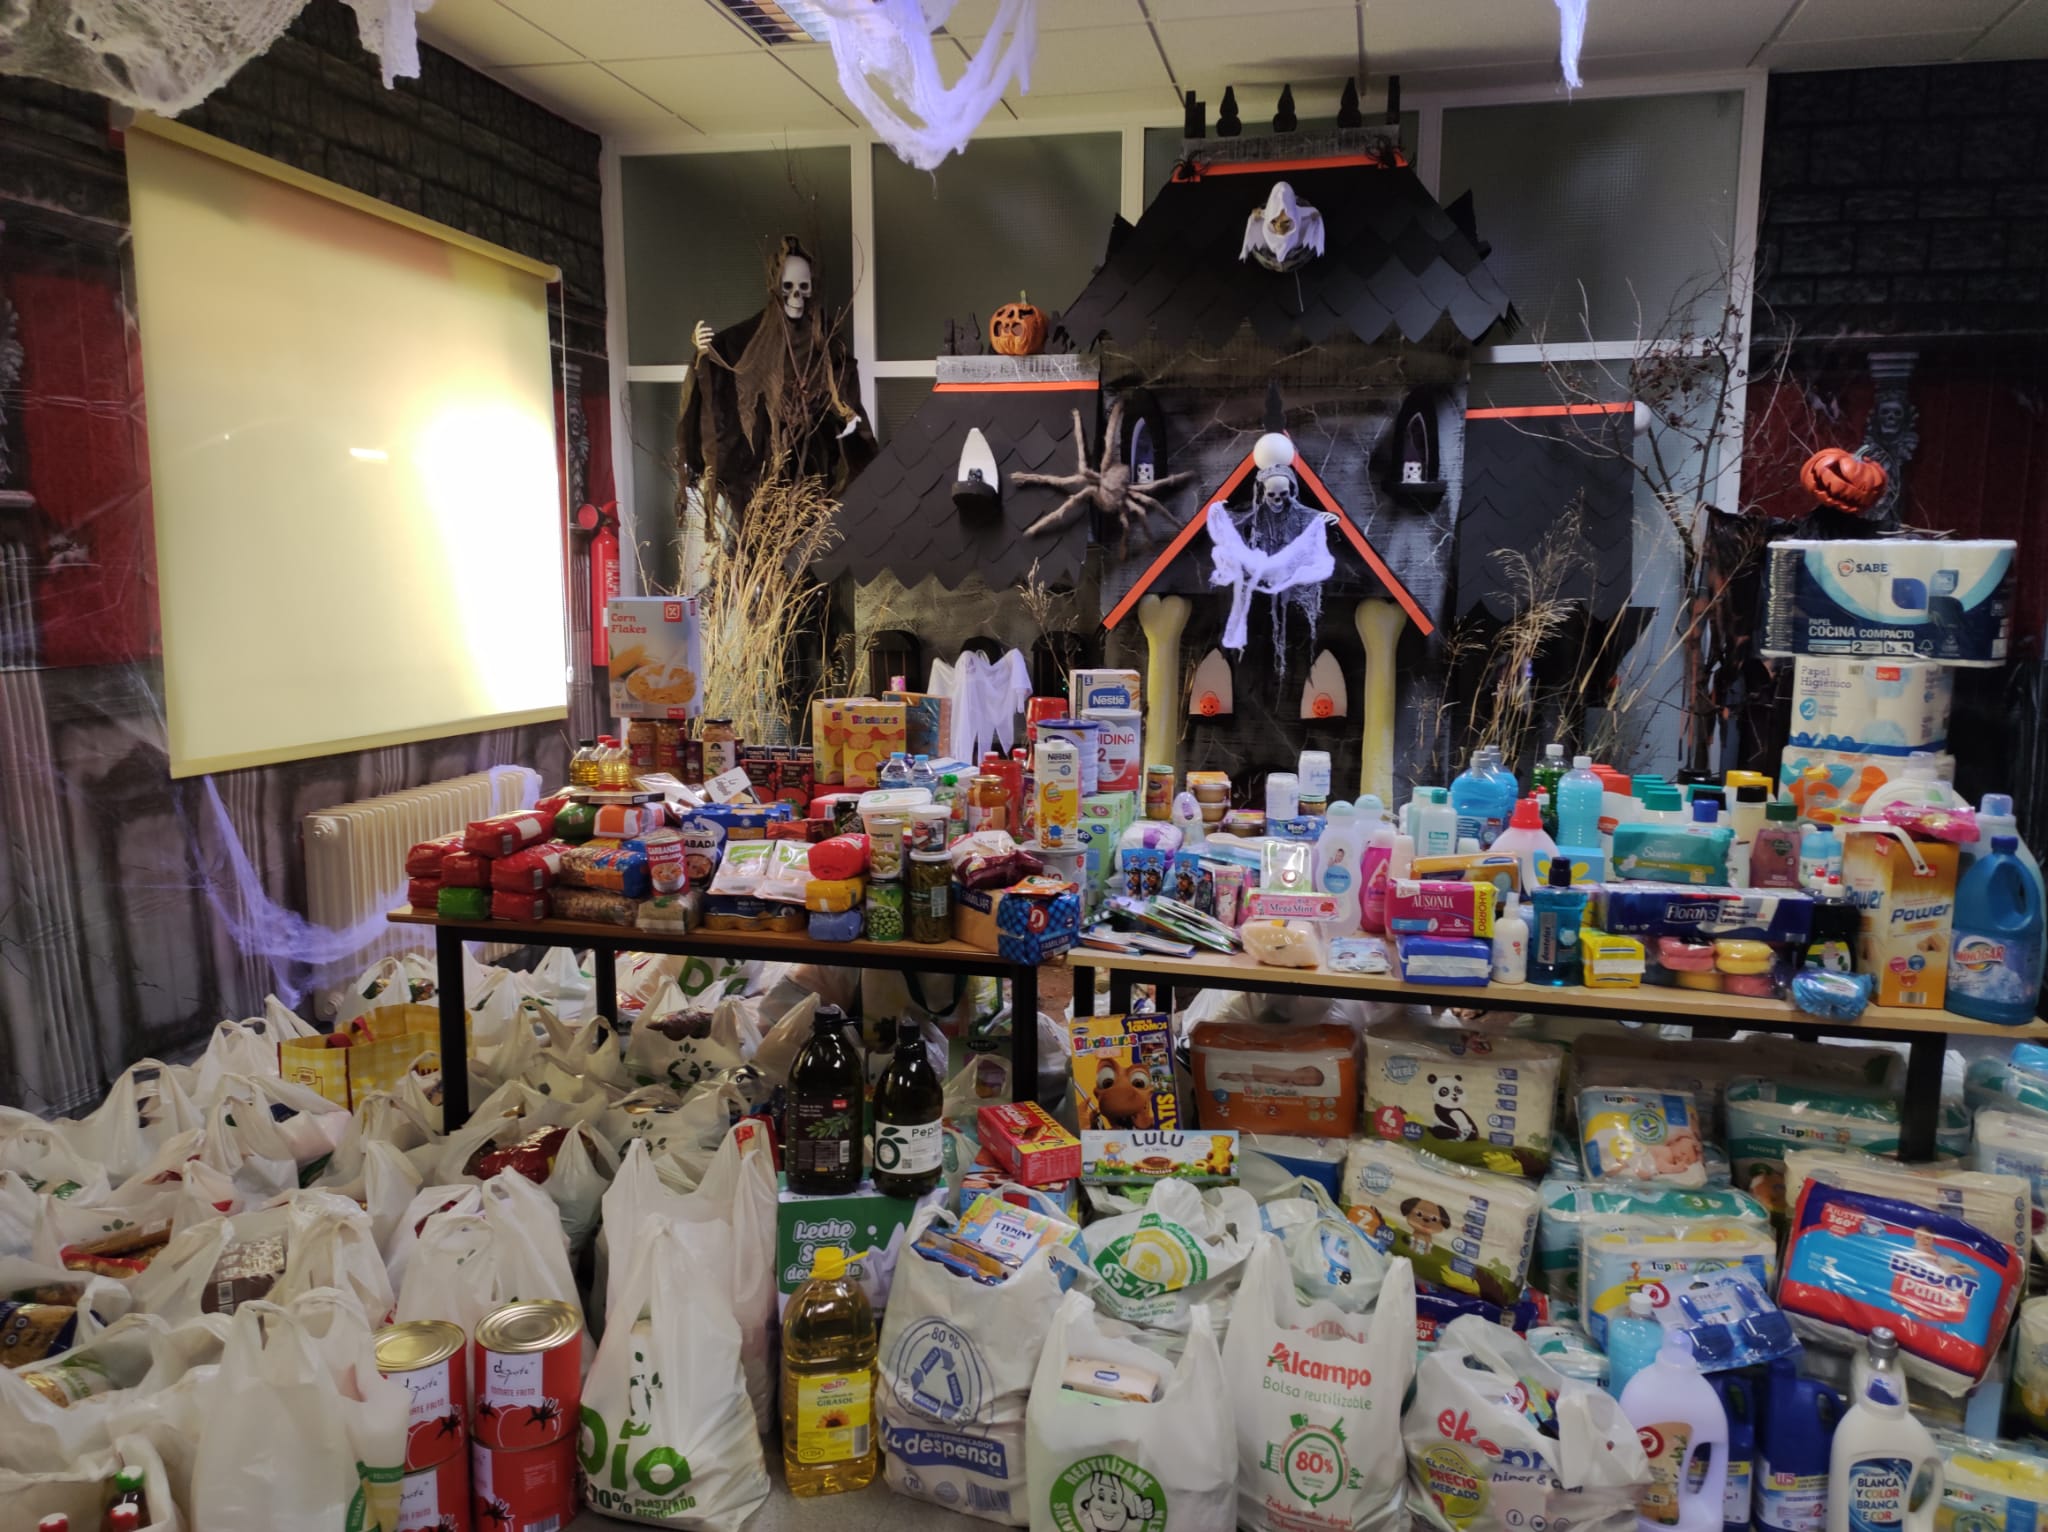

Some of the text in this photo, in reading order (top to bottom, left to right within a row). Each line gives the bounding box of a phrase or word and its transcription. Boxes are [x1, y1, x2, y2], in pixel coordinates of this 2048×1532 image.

[1856, 563, 1889, 573] SABE
[611, 613, 636, 623] Corn
[611, 624, 647, 634] Flakes
[1808, 625, 1915, 640] COCINA COMPACTO
[1853, 641, 1864, 652] 2
[1800, 665, 1832, 678] Papel
[1092, 695, 1126, 705] Nestlé
[1097, 733, 1135, 745] IDINA
[1097, 747, 1107, 763] 2
[684, 839, 716, 849] ABADA
[1411, 894, 1454, 909] AUSONIA
[1478, 890, 1488, 932] AHORRO
[1891, 903, 1953, 924] Power
[1156, 1094, 1177, 1131] ATIS
[1131, 1131, 1184, 1148] LULU
[1356, 1210, 1374, 1230] 2
[795, 1220, 853, 1240] Leche
[800, 1242, 849, 1263] Si
[1101, 1262, 1161, 1298] 65-70
[930, 1326, 960, 1351] 80 %
[1266, 1341, 1372, 1391] Alcampo
[1262, 1375, 1373, 1411] Bolsa reutilizable
[816, 1397, 853, 1408] GIRASOL
[904, 1432, 1002, 1467] despensa
[1295, 1450, 1334, 1475] 80%
[1429, 1467, 1478, 1490] PRECIO
[1857, 1477, 1899, 1488] BLANCA
[1431, 1481, 1480, 1501] MERCADO
[1855, 1488, 1900, 1500] Y COLOR
[1943, 1487, 1976, 1502] pilu
[1856, 1499, 1899, 1510] BRANCA
[1862, 1510, 1892, 1521] E COR
